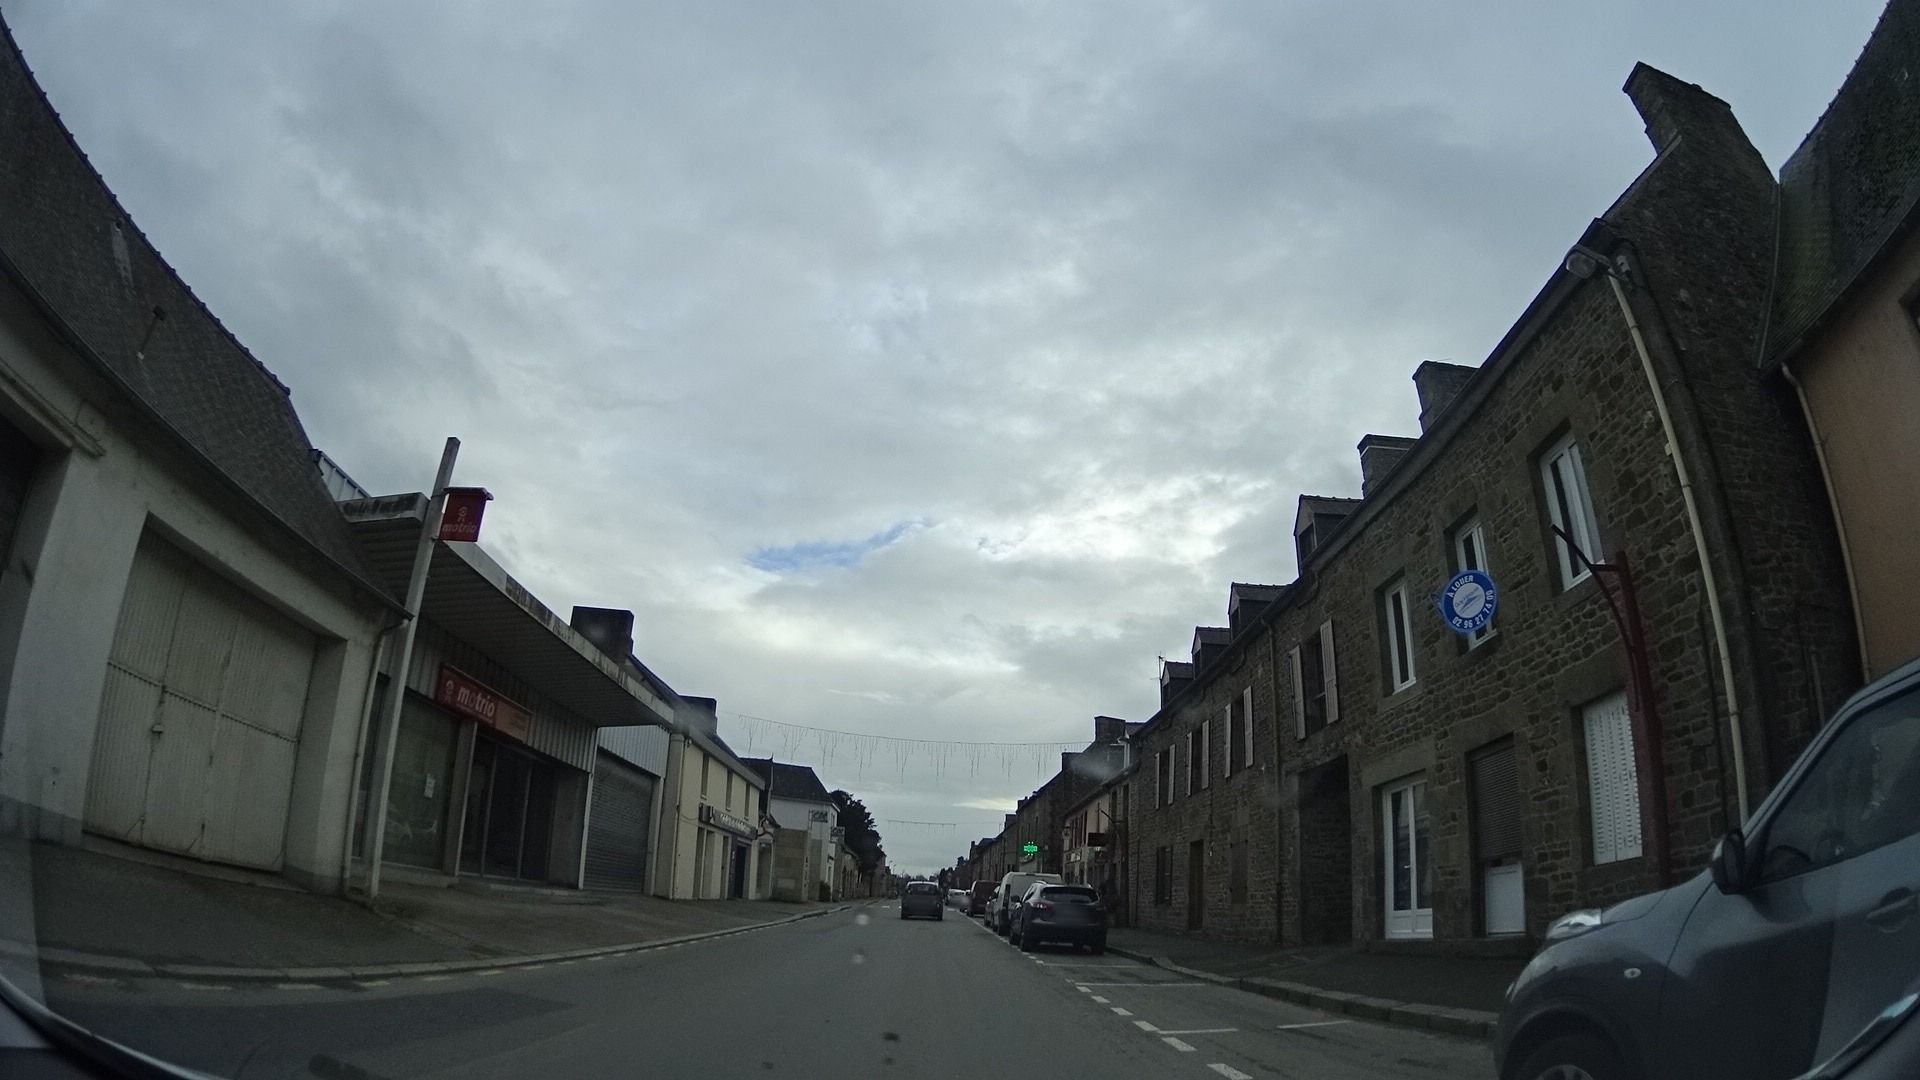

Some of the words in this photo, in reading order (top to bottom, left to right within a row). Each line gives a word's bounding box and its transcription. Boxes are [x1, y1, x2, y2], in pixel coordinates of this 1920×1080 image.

[442, 522, 477, 533] motrio
[1452, 575, 1474, 591] LOUER
[1486, 589, 1494, 600] 00
[1482, 603, 1493, 614] 74
[1452, 616, 1463, 627] 02
[1475, 614, 1484, 625] 27
[457, 687, 495, 717] motrio
